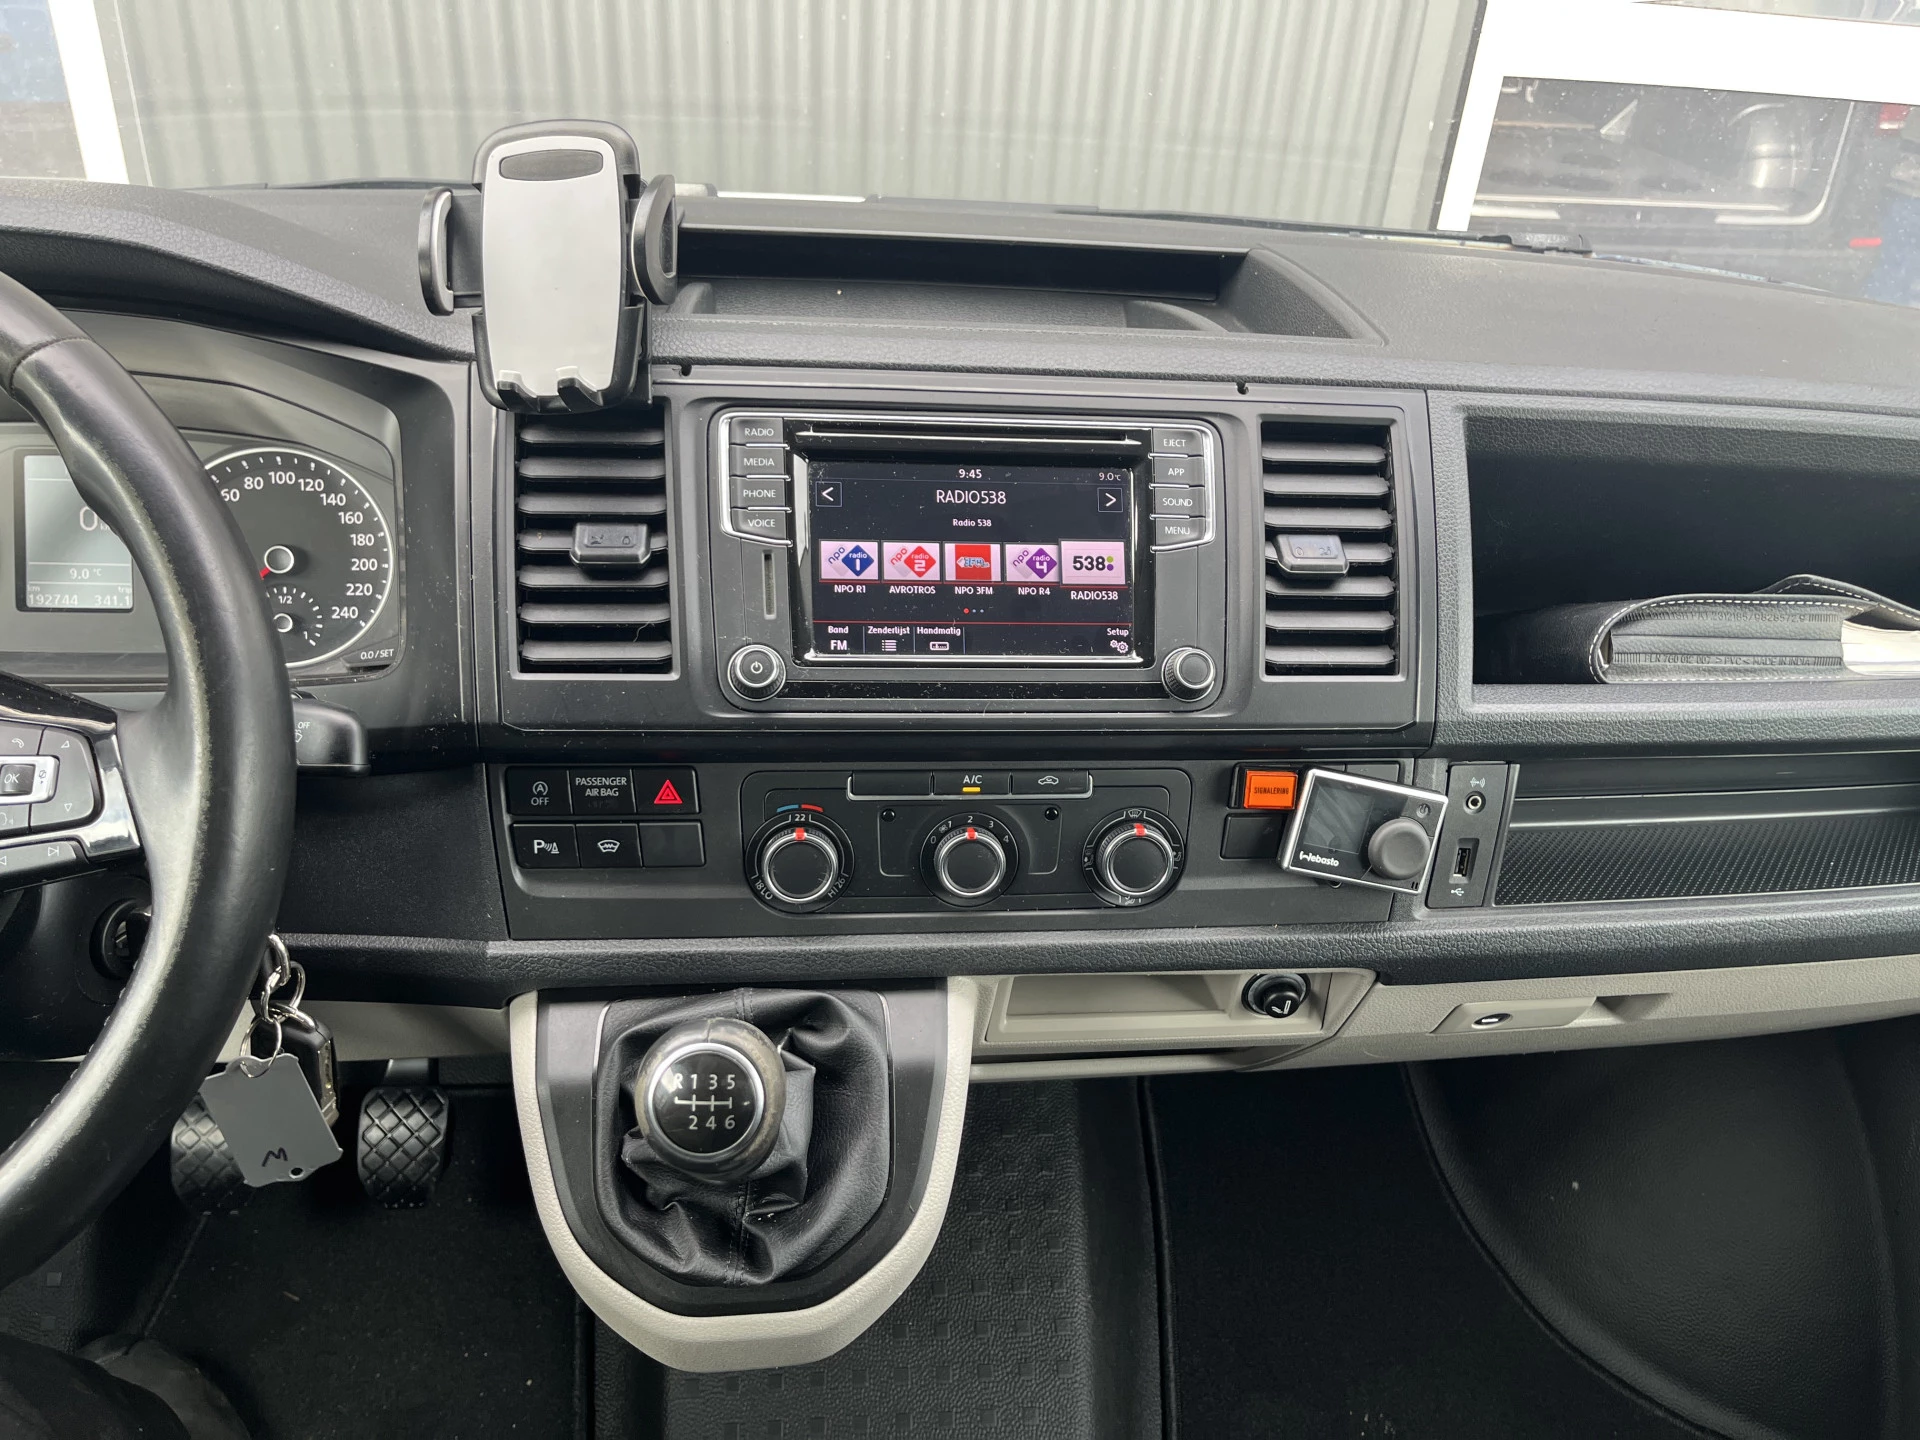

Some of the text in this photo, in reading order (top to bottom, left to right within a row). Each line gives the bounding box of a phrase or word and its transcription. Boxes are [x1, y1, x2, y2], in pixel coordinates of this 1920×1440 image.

[744, 427, 774, 436] RADIO
[1163, 439, 1187, 447] EJECT
[743, 457, 775, 466] MEDIA
[958, 468, 983, 479] 9:45
[1167, 467, 1185, 476] APP
[243, 476, 264, 490] 80
[268, 471, 296, 485] 100
[297, 478, 325, 492] 120
[742, 489, 777, 498] PHONE
[936, 489, 1007, 504] RADIO538
[319, 493, 347, 506] 140
[1162, 497, 1193, 507] SOUND
[80, 506, 98, 531] 0
[338, 511, 364, 525] 160
[747, 518, 776, 528] VOICE
[952, 518, 992, 527] Radio 538
[1164, 526, 1191, 535] MENU
[350, 533, 375, 547] 180
[828, 546, 846, 565] npo
[848, 551, 868, 559] radio
[890, 547, 908, 565] npo
[911, 552, 929, 560] radio
[1012, 549, 1029, 567] npo
[1032, 554, 1051, 562] radio
[351, 558, 378, 571] 200
[913, 559, 926, 572] 2
[1035, 561, 1048, 574] 4
[69, 568, 90, 580] 9.0
[345, 583, 373, 596] 220
[834, 584, 866, 593] NPO R1
[889, 585, 936, 594] AVROTROS
[954, 586, 993, 595] NPO 3FM
[1018, 587, 1051, 595] NPO R4
[29, 594, 79, 606] 192744
[94, 594, 131, 606] 341.1
[278, 595, 293, 604] 1/2
[1070, 590, 1119, 601] RADIO538
[331, 606, 359, 619] 240
[827, 625, 849, 634] Band
[867, 625, 911, 636] Zenderlijst
[916, 626, 961, 636] Handmatig
[1106, 627, 1129, 637] Setup
[303, 631, 308, 640] 1
[830, 639, 848, 651] FM
[298, 721, 311, 729] OFF
[4, 773, 21, 784] OK
[575, 777, 628, 786] PASSENGER
[962, 774, 983, 784] A/C
[585, 788, 619, 797] AIR BAG
[1254, 786, 1290, 795] SIGNALERING
[530, 797, 550, 806] OFF
[794, 813, 806, 822] 22
[930, 815, 1009, 844] 0 1 2 3 4
[1299, 850, 1340, 867] Webasto
[673, 1074, 736, 1090] R 1 3 5
[688, 1115, 735, 1130] 2 4 6
